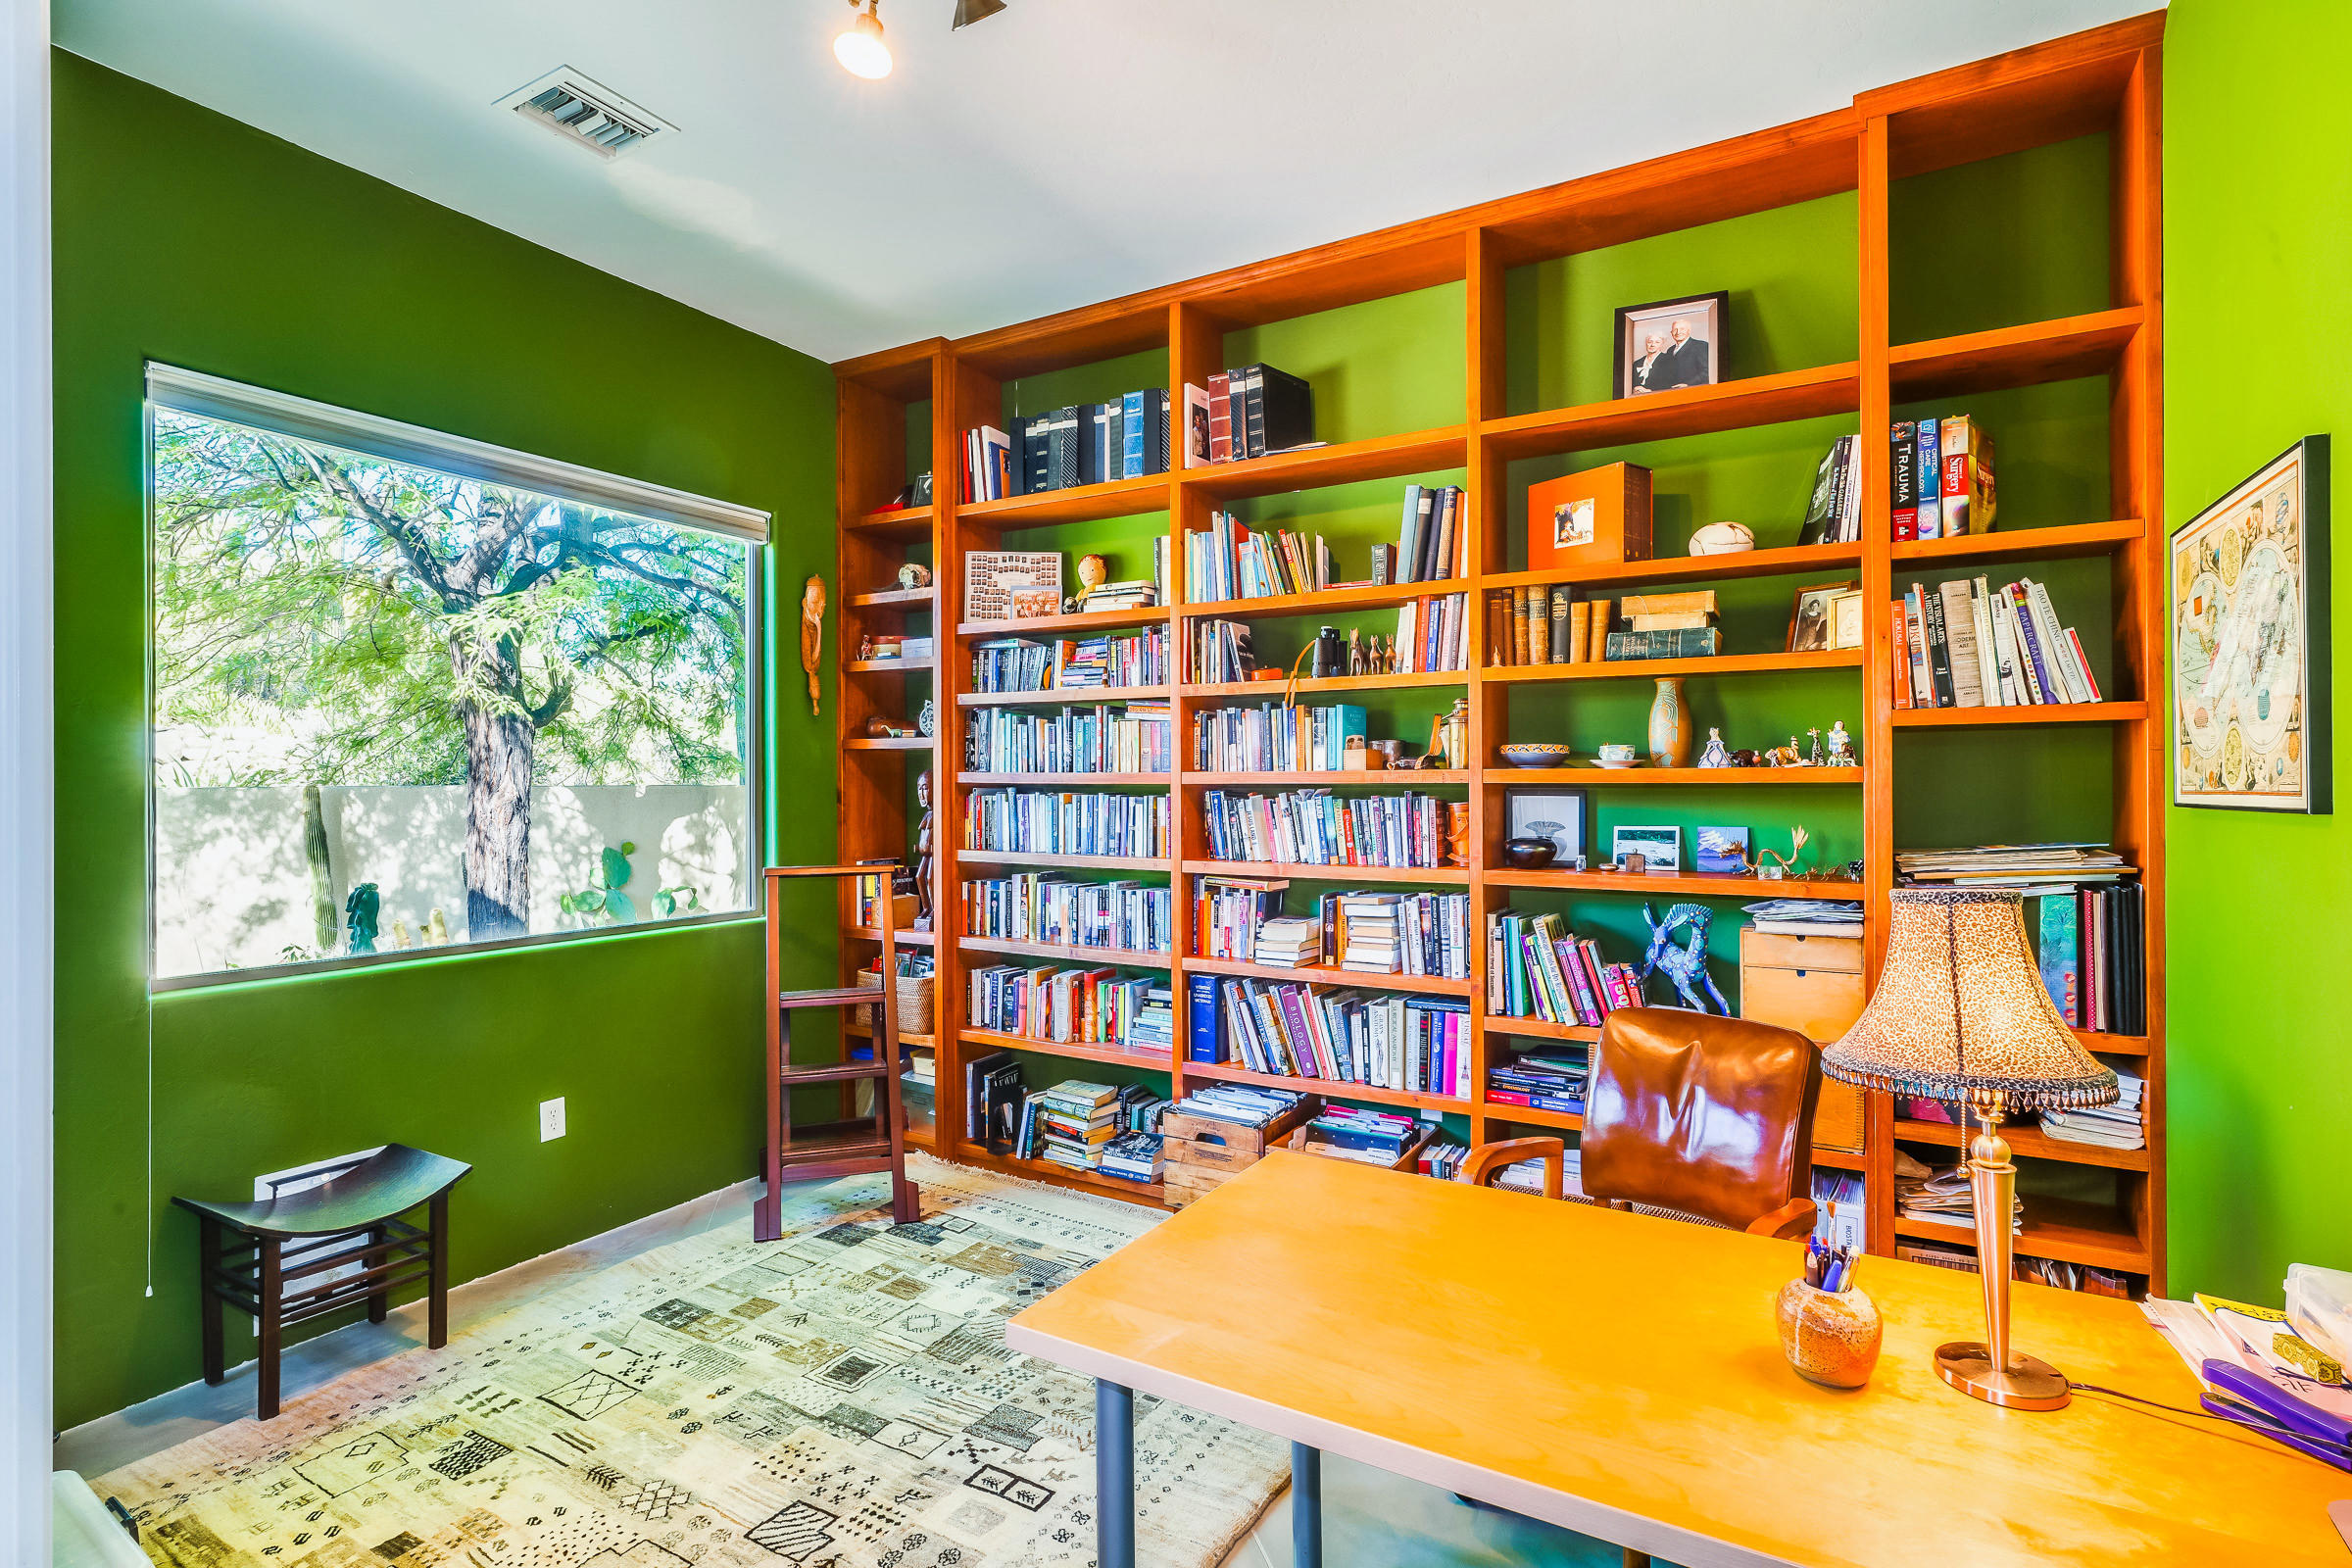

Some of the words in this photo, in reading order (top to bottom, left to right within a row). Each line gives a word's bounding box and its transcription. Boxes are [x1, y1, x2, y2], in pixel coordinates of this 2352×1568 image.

[1898, 444, 1911, 503] TRAUMA
[1946, 458, 1963, 492] Surgery
[1836, 489, 1845, 514] GALLERY
[1926, 600, 1936, 625] HISTORY
[1932, 593, 1941, 606] THE
[1934, 606, 1943, 627] VISUAL
[2036, 589, 2046, 604] TAO
[2042, 604, 2050, 615] TE
[2046, 615, 2063, 642] CHING
[1895, 617, 1904, 646] HOKUSAI
[2020, 612, 2042, 665] PAPERCRAFT
[1540, 929, 1551, 952] Landscape
[1290, 1005, 1307, 1054] BIOLOGY
